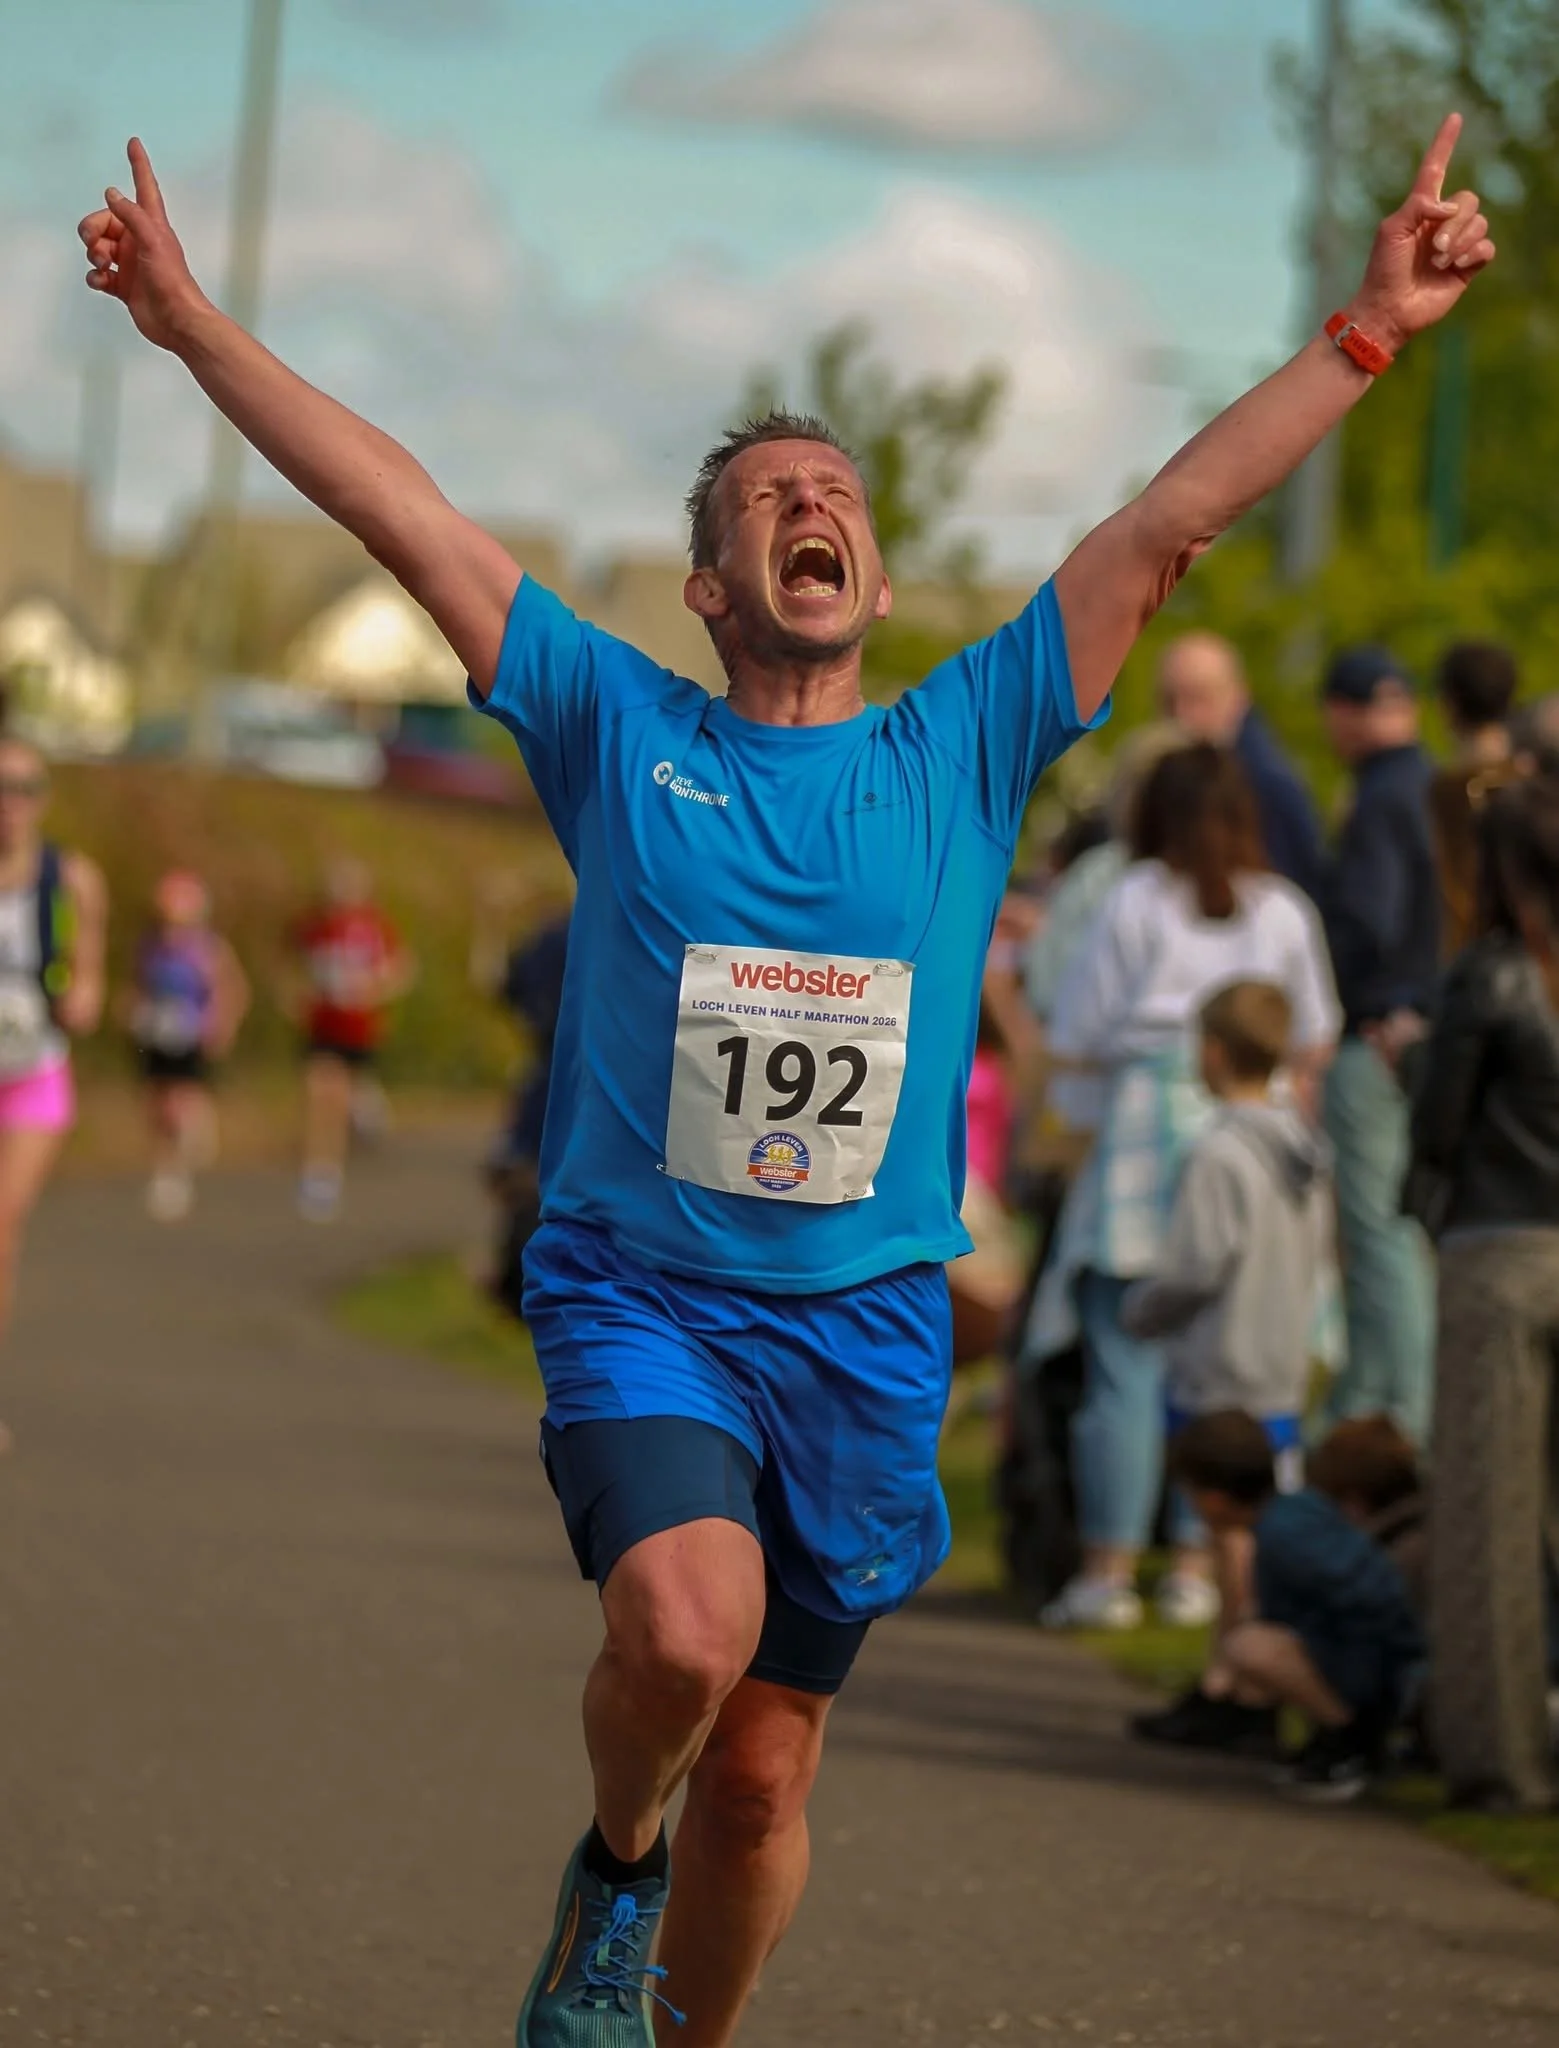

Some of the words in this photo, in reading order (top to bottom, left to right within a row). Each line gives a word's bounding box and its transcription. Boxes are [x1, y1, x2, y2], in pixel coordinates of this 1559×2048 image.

[675, 775, 694, 788] TEVE
[730, 961, 871, 999] webster
[692, 1000, 725, 1013] LOCH
[728, 1003, 767, 1017] LEVEN
[770, 1007, 801, 1020] HALF
[804, 1011, 870, 1025] MARATHON
[872, 1016, 897, 1027] 2026
[717, 1035, 868, 1127] 192
[759, 1135, 780, 1149] LOCH
[781, 1135, 804, 1152] LEVEN
[760, 1167, 797, 1178] webster
